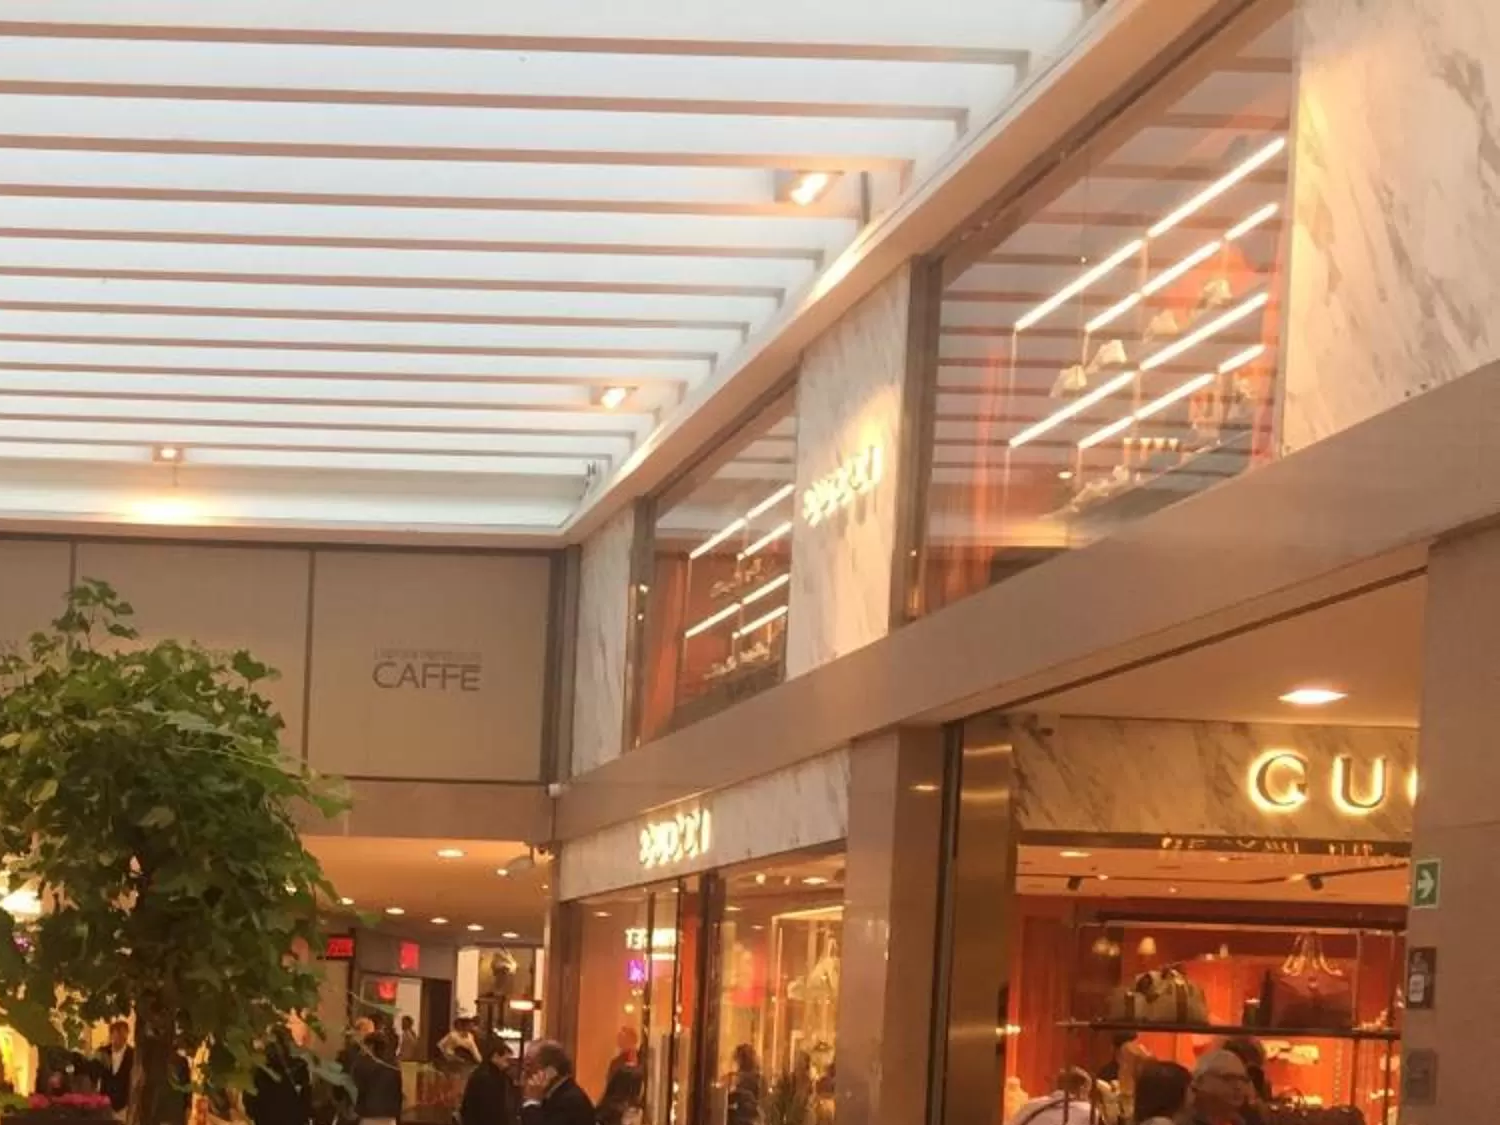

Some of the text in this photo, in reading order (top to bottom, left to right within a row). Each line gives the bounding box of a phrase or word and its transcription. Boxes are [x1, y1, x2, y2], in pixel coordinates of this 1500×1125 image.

[372, 661, 482, 692] CAFFE
[1248, 749, 1418, 816] GU
[639, 808, 711, 869] GUCCI
